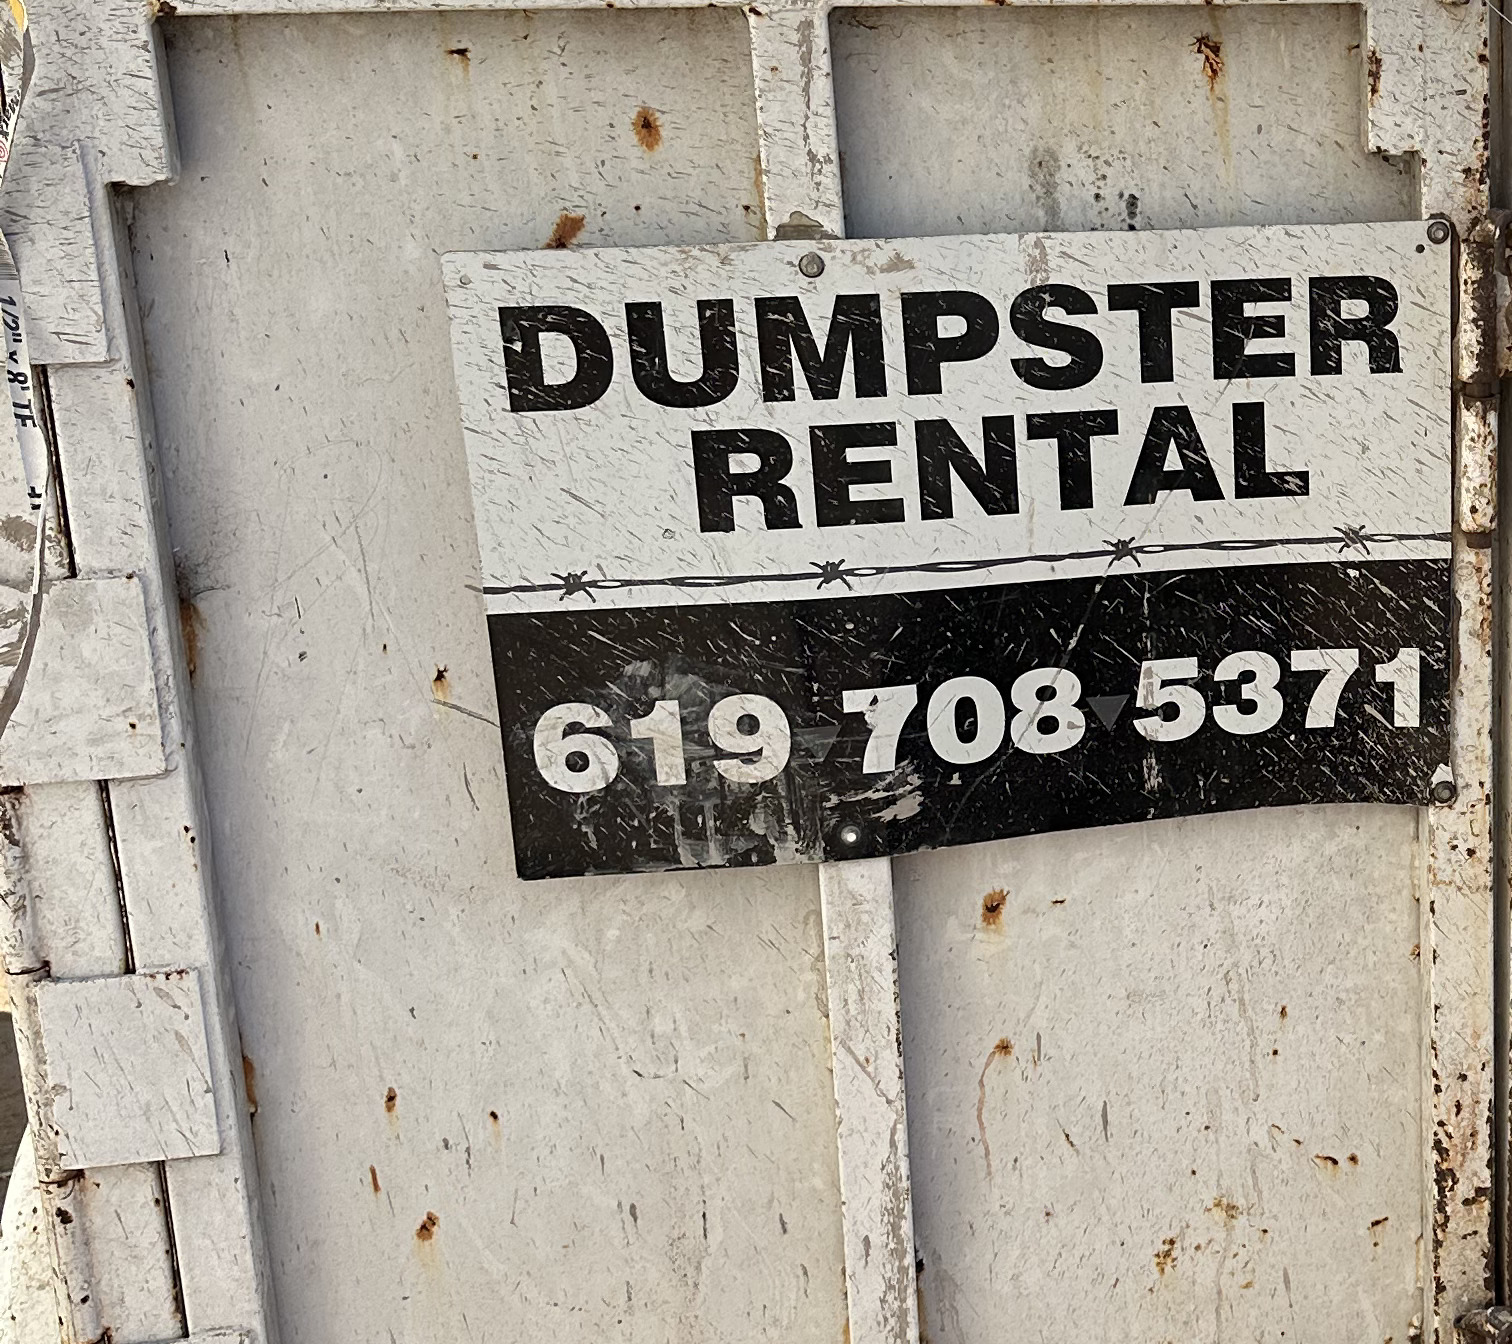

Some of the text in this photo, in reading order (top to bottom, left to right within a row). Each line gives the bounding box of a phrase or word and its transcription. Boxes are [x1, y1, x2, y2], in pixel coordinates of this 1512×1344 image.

[497, 272, 1405, 415] DUMPSTER
[690, 401, 1310, 534] RENTAL
[531, 645, 1423, 795] 619 708 5371
